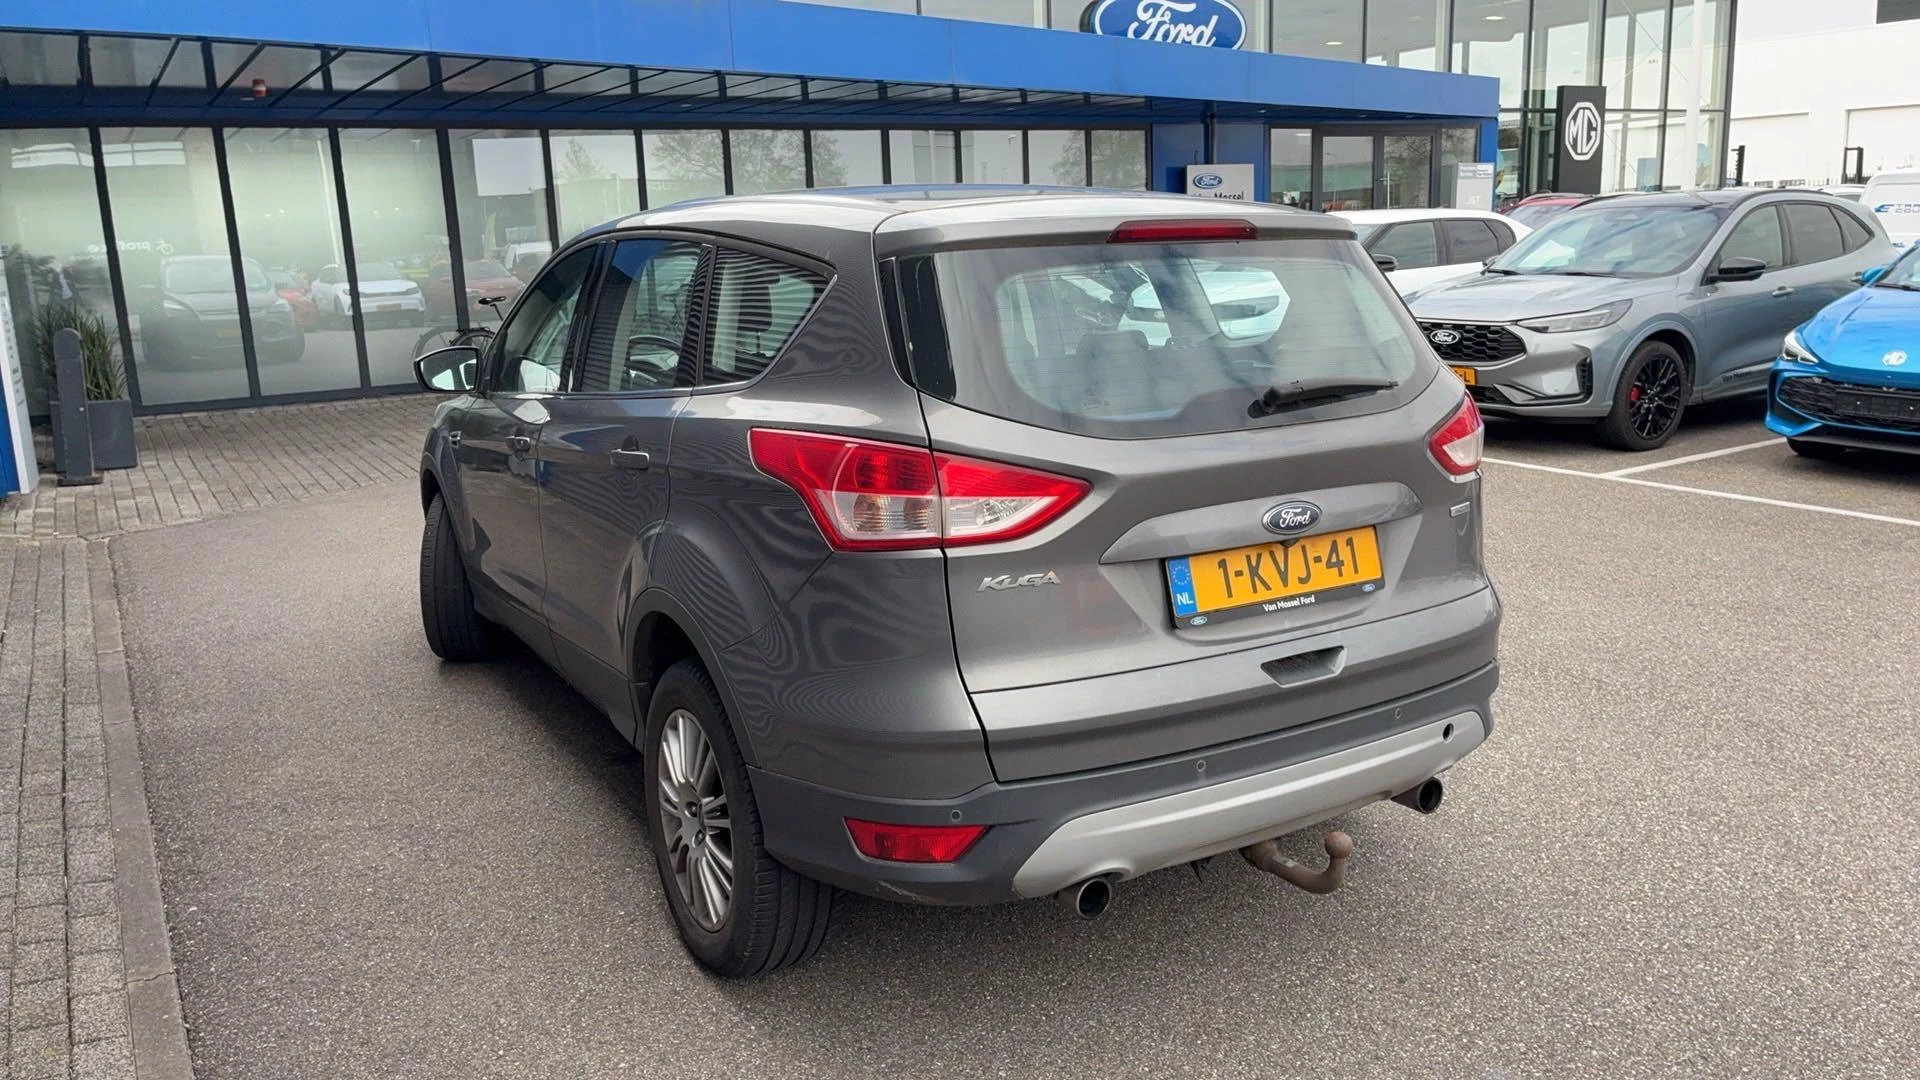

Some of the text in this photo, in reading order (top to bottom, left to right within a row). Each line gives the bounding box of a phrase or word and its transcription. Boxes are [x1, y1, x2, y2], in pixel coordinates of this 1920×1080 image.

[1127, 0, 1220, 47] Ford
[1568, 107, 1598, 155] MG
[1279, 507, 1311, 528] Ford
[1216, 536, 1360, 599] 1-KVJ-41
[976, 570, 1061, 592] KUGA
[1176, 592, 1194, 606] NL
[1262, 594, 1316, 612] Van Mossel Ford
